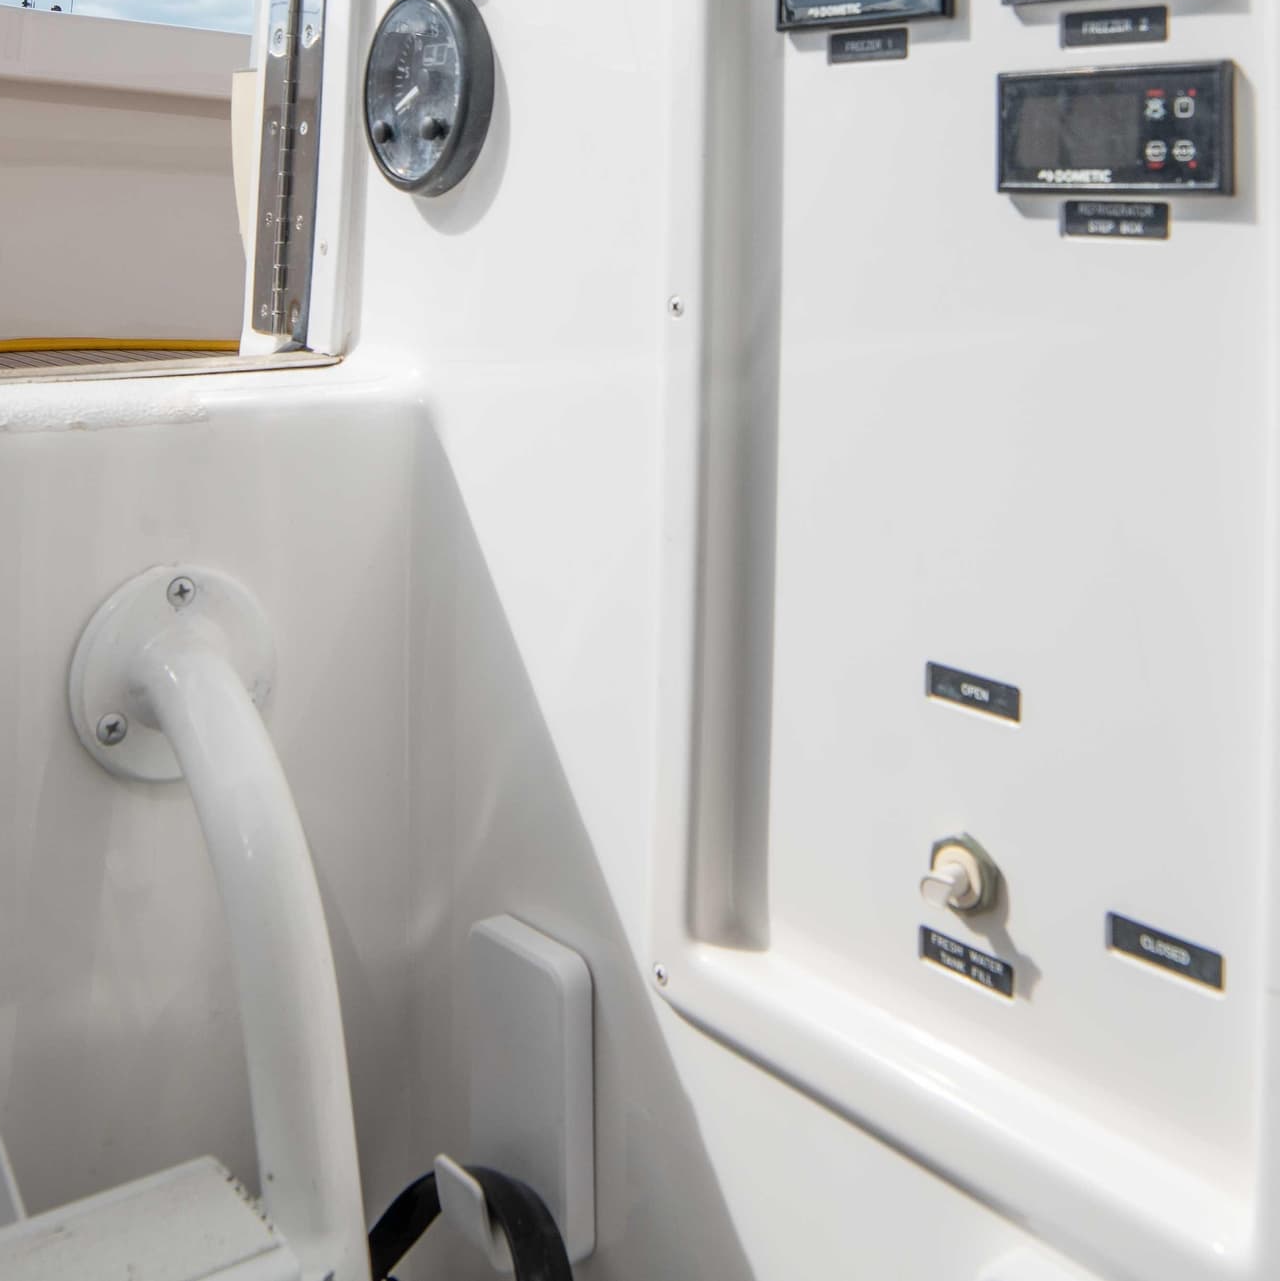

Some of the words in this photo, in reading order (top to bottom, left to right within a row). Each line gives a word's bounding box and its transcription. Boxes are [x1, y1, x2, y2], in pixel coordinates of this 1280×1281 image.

[820, 3, 862, 17] DOMETIC
[1082, 19, 1132, 35] FREEZER
[844, 40, 883, 53] FREEZER
[1053, 169, 1113, 184] DOMETIC
[1078, 203, 1154, 217] REFRIGERATOR
[961, 683, 989, 702] OPEN
[931, 932, 964, 957] FRESH
[967, 949, 1004, 976] WATER
[1139, 933, 1192, 967] CLOSED
